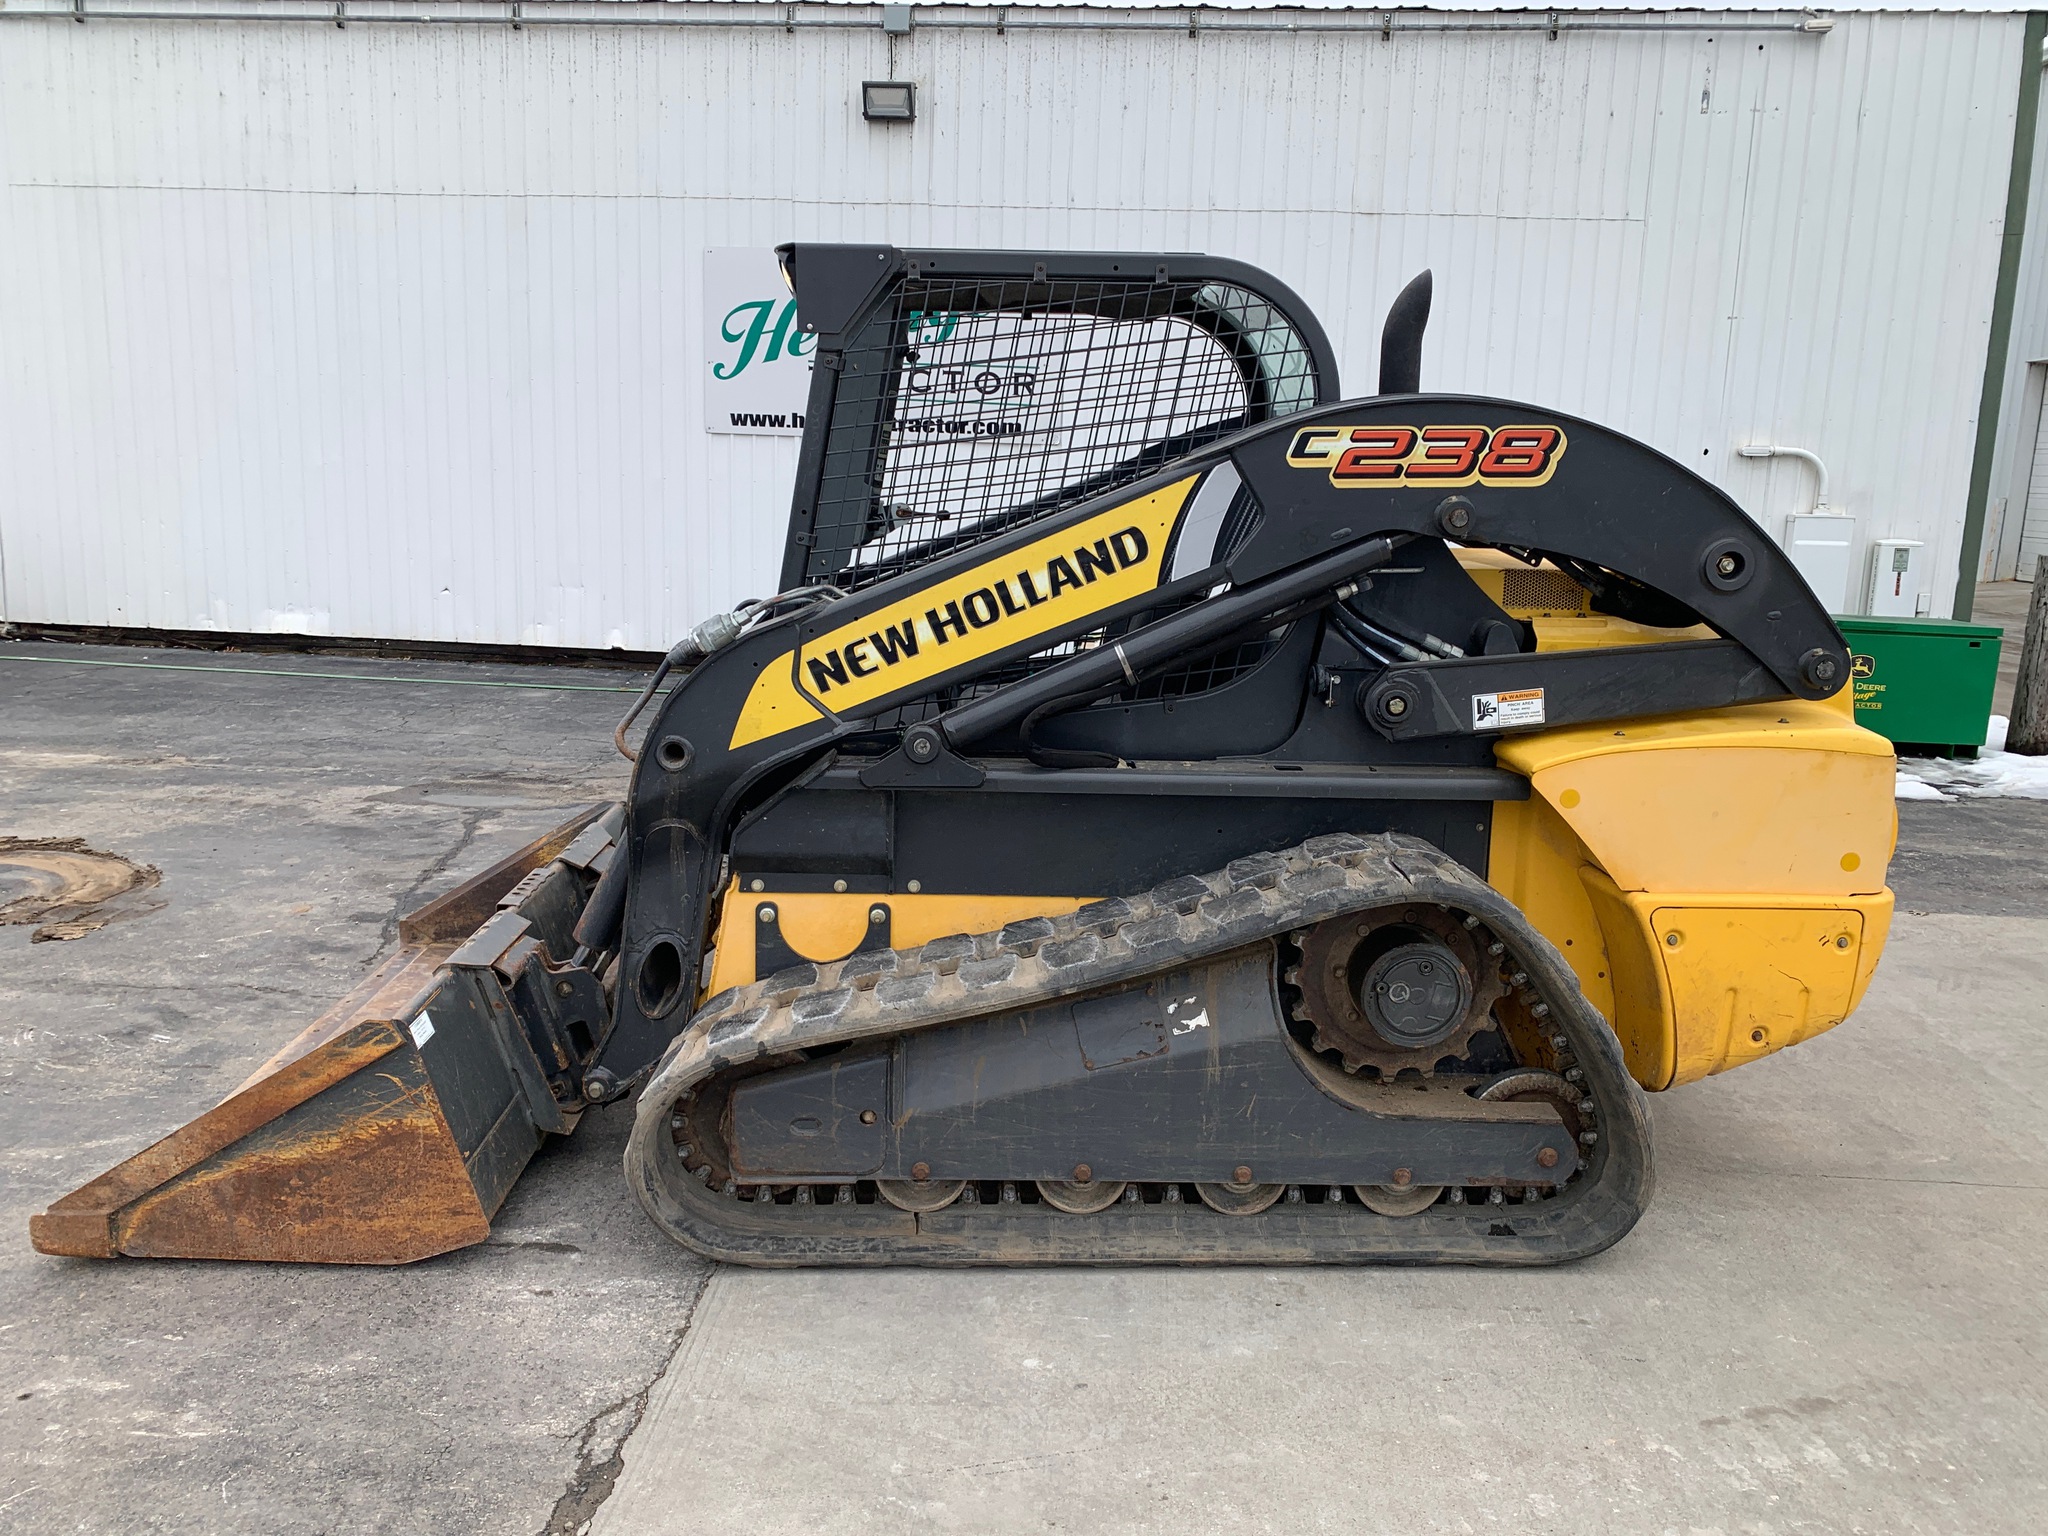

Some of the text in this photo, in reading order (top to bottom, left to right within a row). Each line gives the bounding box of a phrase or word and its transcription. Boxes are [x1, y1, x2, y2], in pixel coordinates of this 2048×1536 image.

[1286, 425, 1568, 488] C238
[806, 525, 1150, 694] NEW HOLLAND
[1855, 682, 1887, 692] DEERE
[1508, 691, 1540, 700] WARNING
[1855, 702, 1882, 710] ACTOR
